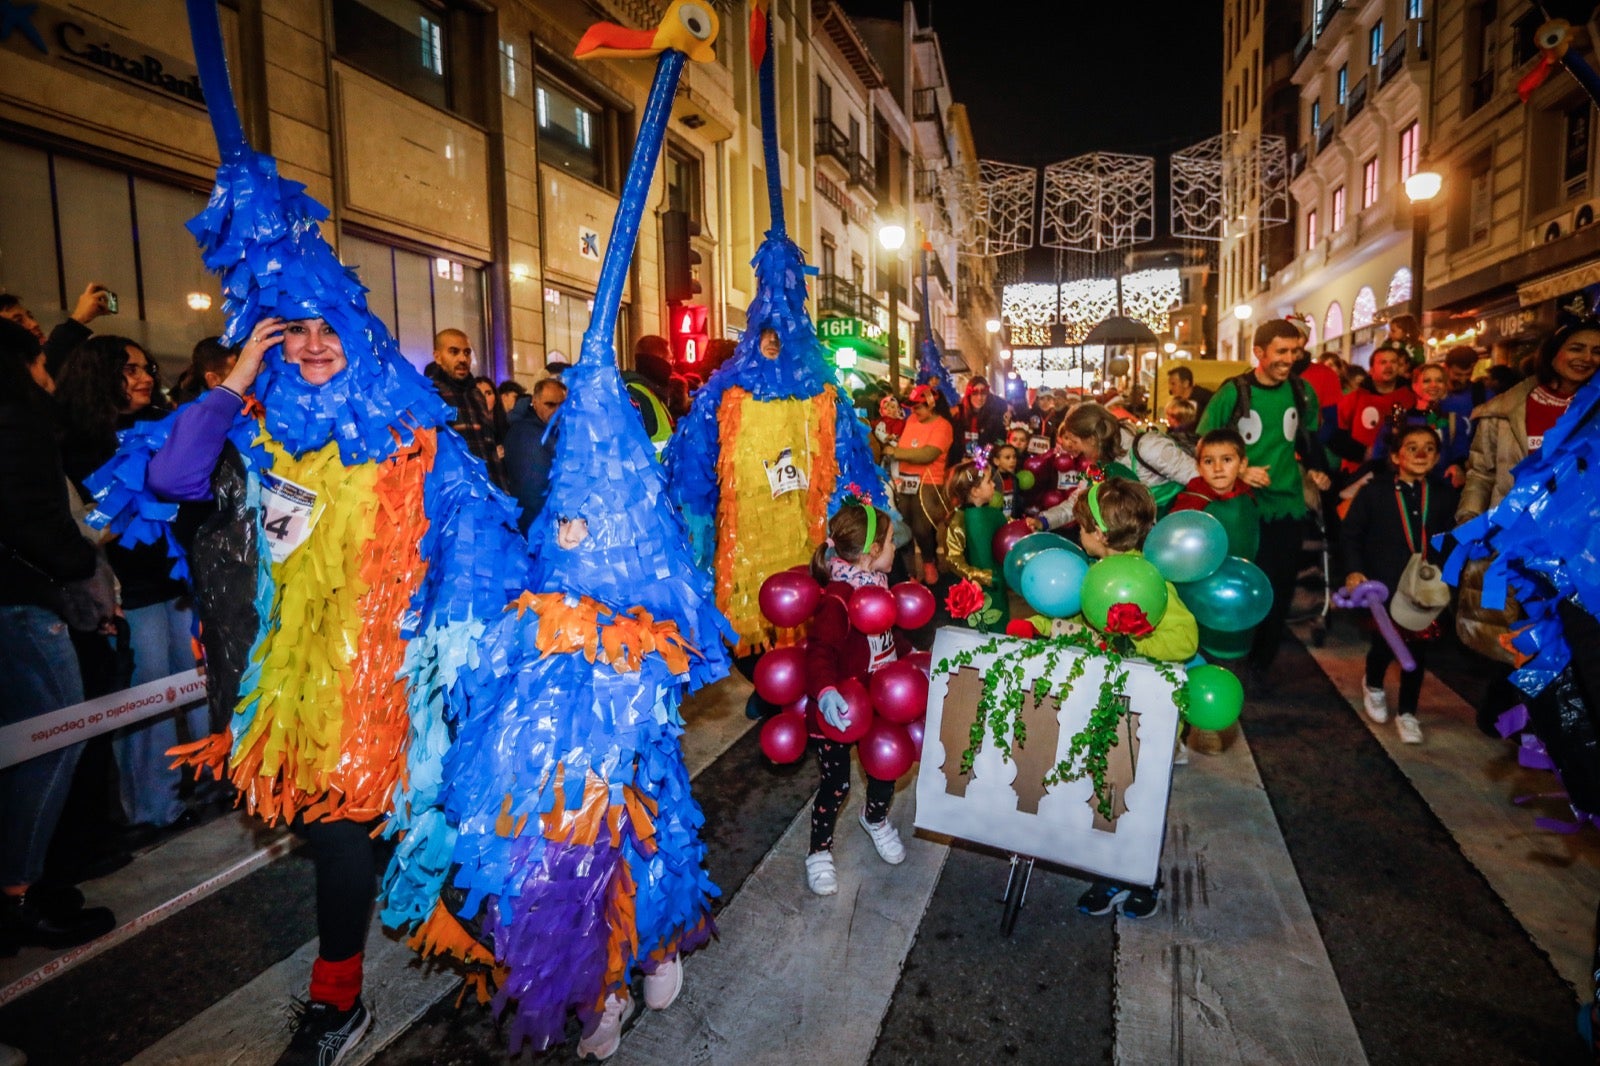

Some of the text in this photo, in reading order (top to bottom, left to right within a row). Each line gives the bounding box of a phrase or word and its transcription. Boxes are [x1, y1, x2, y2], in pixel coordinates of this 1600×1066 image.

[821, 320, 853, 336] 16H
[88, 712, 104, 725] de
[31, 717, 86, 743] Deportes
